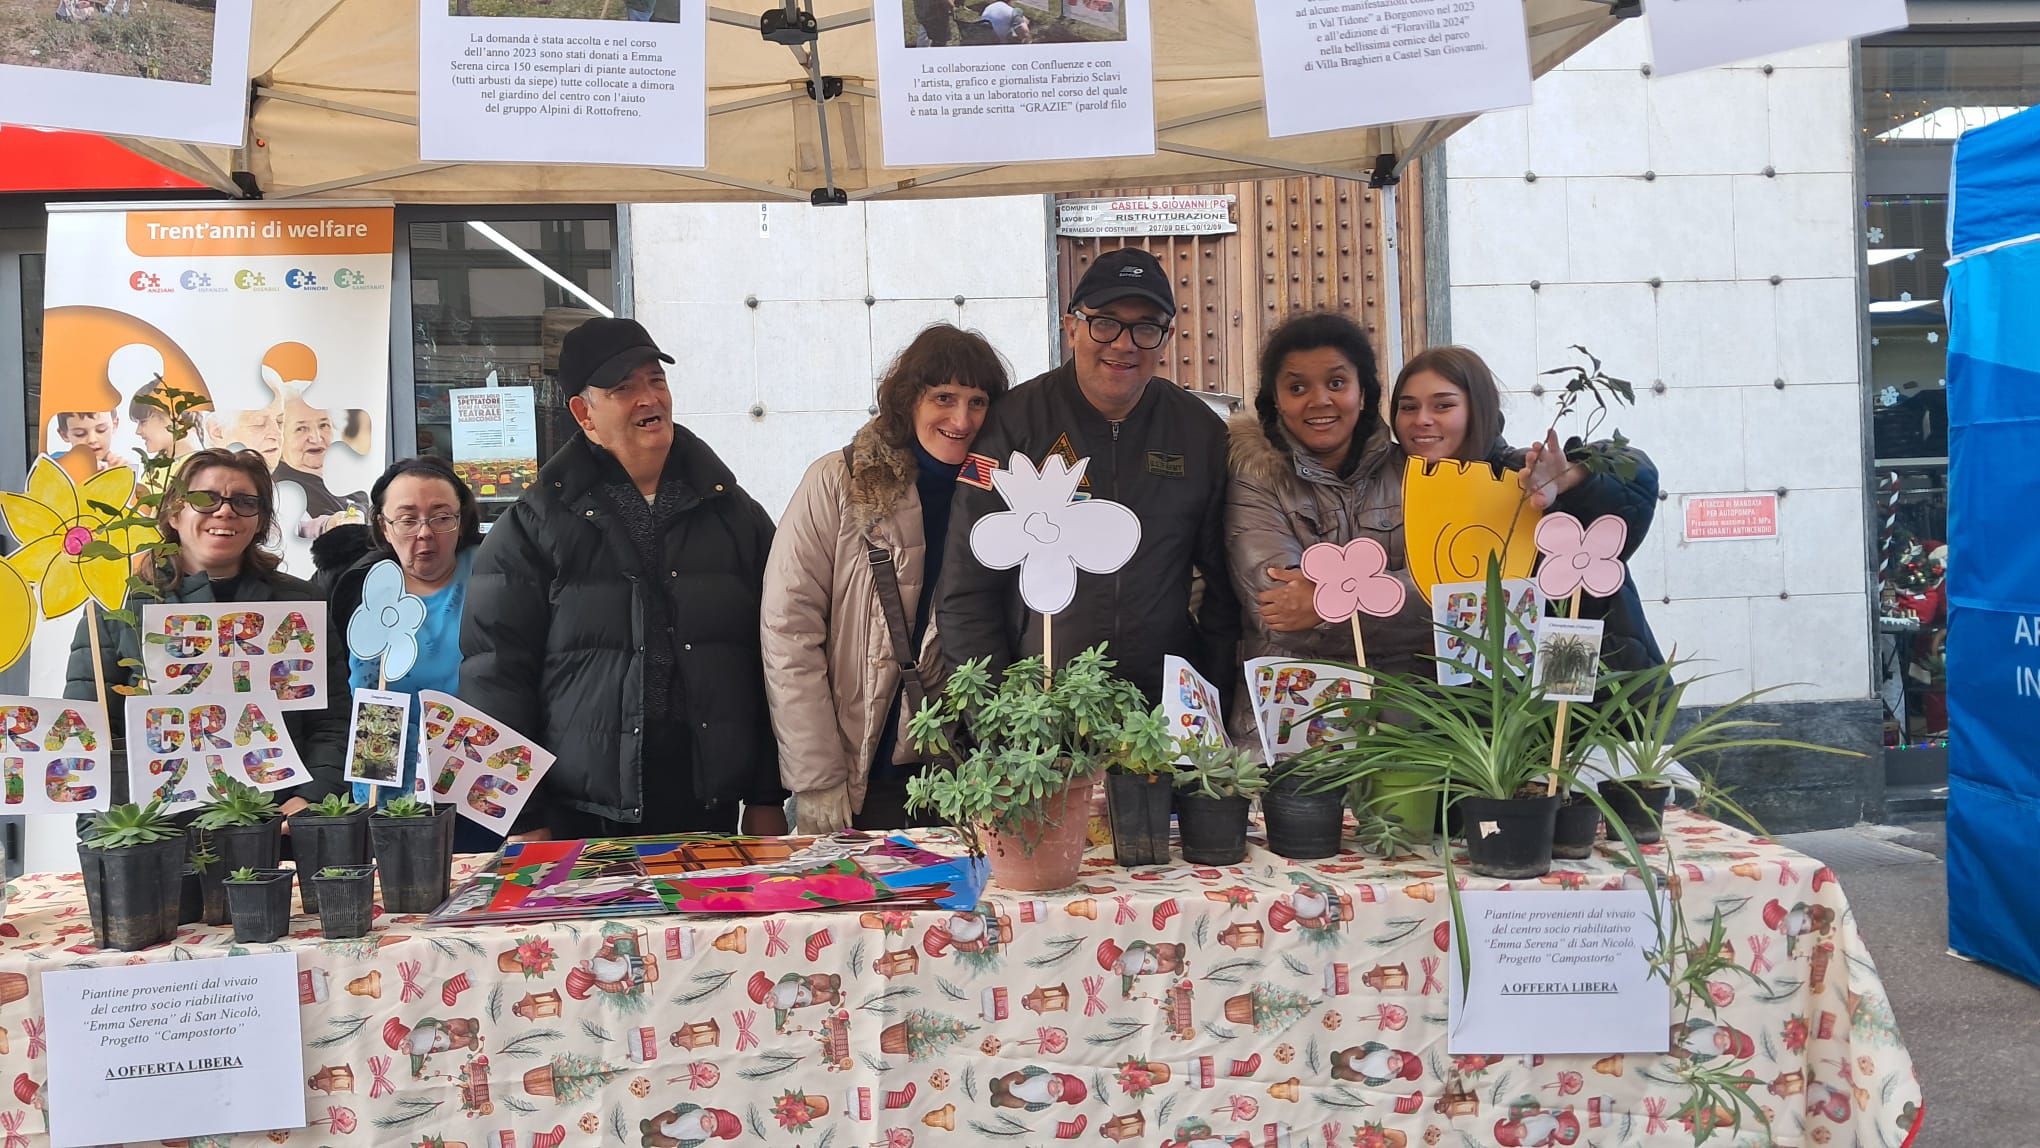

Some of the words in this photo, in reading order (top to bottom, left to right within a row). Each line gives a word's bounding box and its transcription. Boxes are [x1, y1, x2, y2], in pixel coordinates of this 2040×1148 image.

[1308, 5, 1340, 16] alcune
[1319, 17, 1335, 27] Val
[1383, 8, 1435, 21] Borgonovo
[1436, 3, 1451, 15] nel
[1452, 0, 1475, 13] 2023
[470, 32, 483, 42] La
[485, 33, 530, 43] domanda
[541, 36, 564, 44] stata
[566, 35, 601, 45] accolta
[612, 36, 627, 47] nel
[630, 40, 656, 48] corso
[1324, 28, 1378, 41] all'edizione
[1319, 44, 1343, 56] nella
[1343, 39, 1391, 52] bellissima
[1392, 36, 1426, 47] cornice
[1427, 32, 1442, 42] del
[1444, 31, 1470, 43] parco
[463, 46, 510, 56] dell'anno
[512, 47, 536, 57] 2023
[539, 50, 563, 58] sono
[565, 49, 586, 59] stati
[588, 49, 619, 60] donati
[631, 51, 662, 62] Emma
[1314, 58, 1339, 69] Villa
[1392, 48, 1422, 60] Castel
[1423, 47, 1441, 56] San
[450, 60, 483, 70] Serena
[486, 63, 510, 71] circa
[514, 61, 531, 71] 150
[533, 62, 580, 75] esemplari
[596, 66, 626, 76] piante
[628, 67, 676, 76] autoctone
[921, 63, 934, 73] La
[936, 62, 1006, 73] collaborazione
[1030, 59, 1084, 70] Confluenze
[1094, 60, 1112, 68] con
[451, 74, 475, 85] (tutti
[478, 75, 511, 85] arbusti
[528, 76, 558, 88] siepe)
[560, 78, 582, 86] tutte
[584, 77, 629, 88] collocate
[639, 79, 675, 90] dimora
[955, 76, 988, 89] grafico
[998, 74, 1048, 88] giornalista
[1050, 72, 1090, 84] Fabrizio
[1091, 71, 1120, 82] Sclavi
[481, 89, 496, 98] nel
[498, 89, 539, 101] giardino
[541, 90, 556, 100] del
[559, 92, 590, 101] centro
[592, 94, 611, 102] con
[613, 92, 646, 103] l'aiuto
[921, 91, 942, 101] dato
[944, 91, 963, 100] vita
[987, 88, 1039, 100] laboratorio
[1040, 87, 1055, 98] nel
[1057, 89, 1083, 97] corso
[1085, 85, 1100, 96] del
[1102, 84, 1128, 98] quale
[484, 102, 500, 112] del
[502, 106, 537, 116] gruppo
[539, 104, 570, 116] Alpini
[918, 107, 938, 116] nata
[951, 104, 984, 117] grande
[986, 103, 1015, 114] scritta
[1110, 98, 1127, 109] filo
[1111, 201, 1150, 210] CASTEL
[1116, 213, 1226, 221] RISTRUTTURAZIONE
[147, 221, 256, 240] Trent'anni
[262, 221, 281, 239] di
[288, 220, 368, 238] welfare
[164, 612, 316, 658] GRA
[146, 703, 278, 753] GRA
[149, 748, 296, 801] ZIE
[1484, 909, 1527, 919] Piantine
[1527, 910, 1584, 922] provenienti
[1586, 907, 1604, 918] dal
[1491, 923, 1508, 934] del
[1510, 925, 1542, 934] centro
[1543, 924, 1570, 934] socio
[1572, 922, 1631, 933] riabilitativo
[1567, 937, 1577, 948] di
[1579, 937, 1598, 948] San
[1498, 953, 1541, 966] Progetto
[81, 987, 129, 1000] Piantine
[131, 980, 198, 999] provenienti
[201, 977, 220, 989] dal
[224, 975, 258, 987] vivaio
[1501, 983, 1509, 992] A
[1512, 982, 1569, 992] OFFERTA
[1572, 982, 1618, 992] LIBERA
[90, 1003, 108, 1015] del
[111, 1003, 147, 1013] centro
[150, 998, 182, 1010] socio
[184, 991, 254, 1006] riabilitativo
[179, 1011, 191, 1023] di
[194, 1010, 216, 1022] San
[100, 1034, 149, 1047] Progetto
[105, 1068, 115, 1078] A
[117, 1061, 184, 1076] OFFERTA
[188, 1056, 242, 1070] LIBERA
